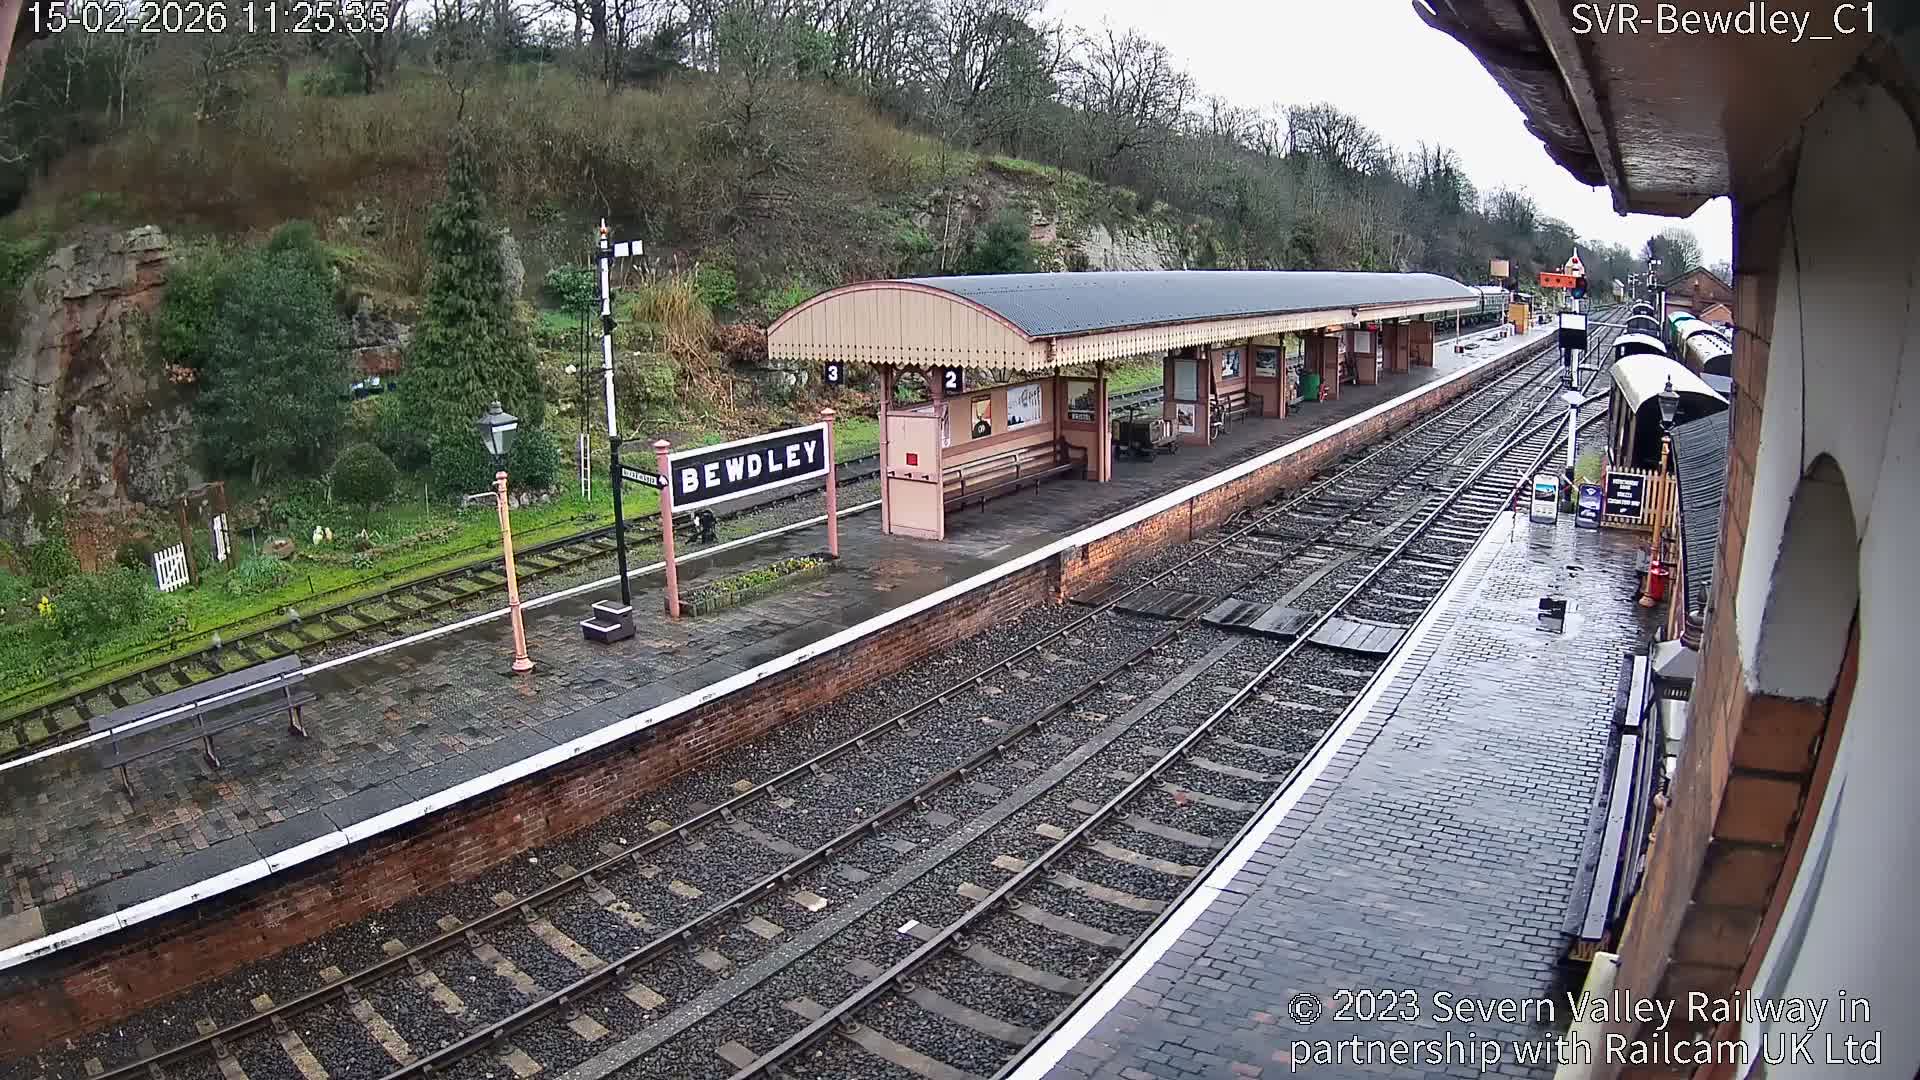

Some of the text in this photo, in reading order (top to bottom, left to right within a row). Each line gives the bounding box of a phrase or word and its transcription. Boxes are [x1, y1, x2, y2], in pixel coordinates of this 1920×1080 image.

[828, 365, 838, 381] 3
[945, 371, 957, 388] 2
[681, 440, 817, 494] BEWDLEY
